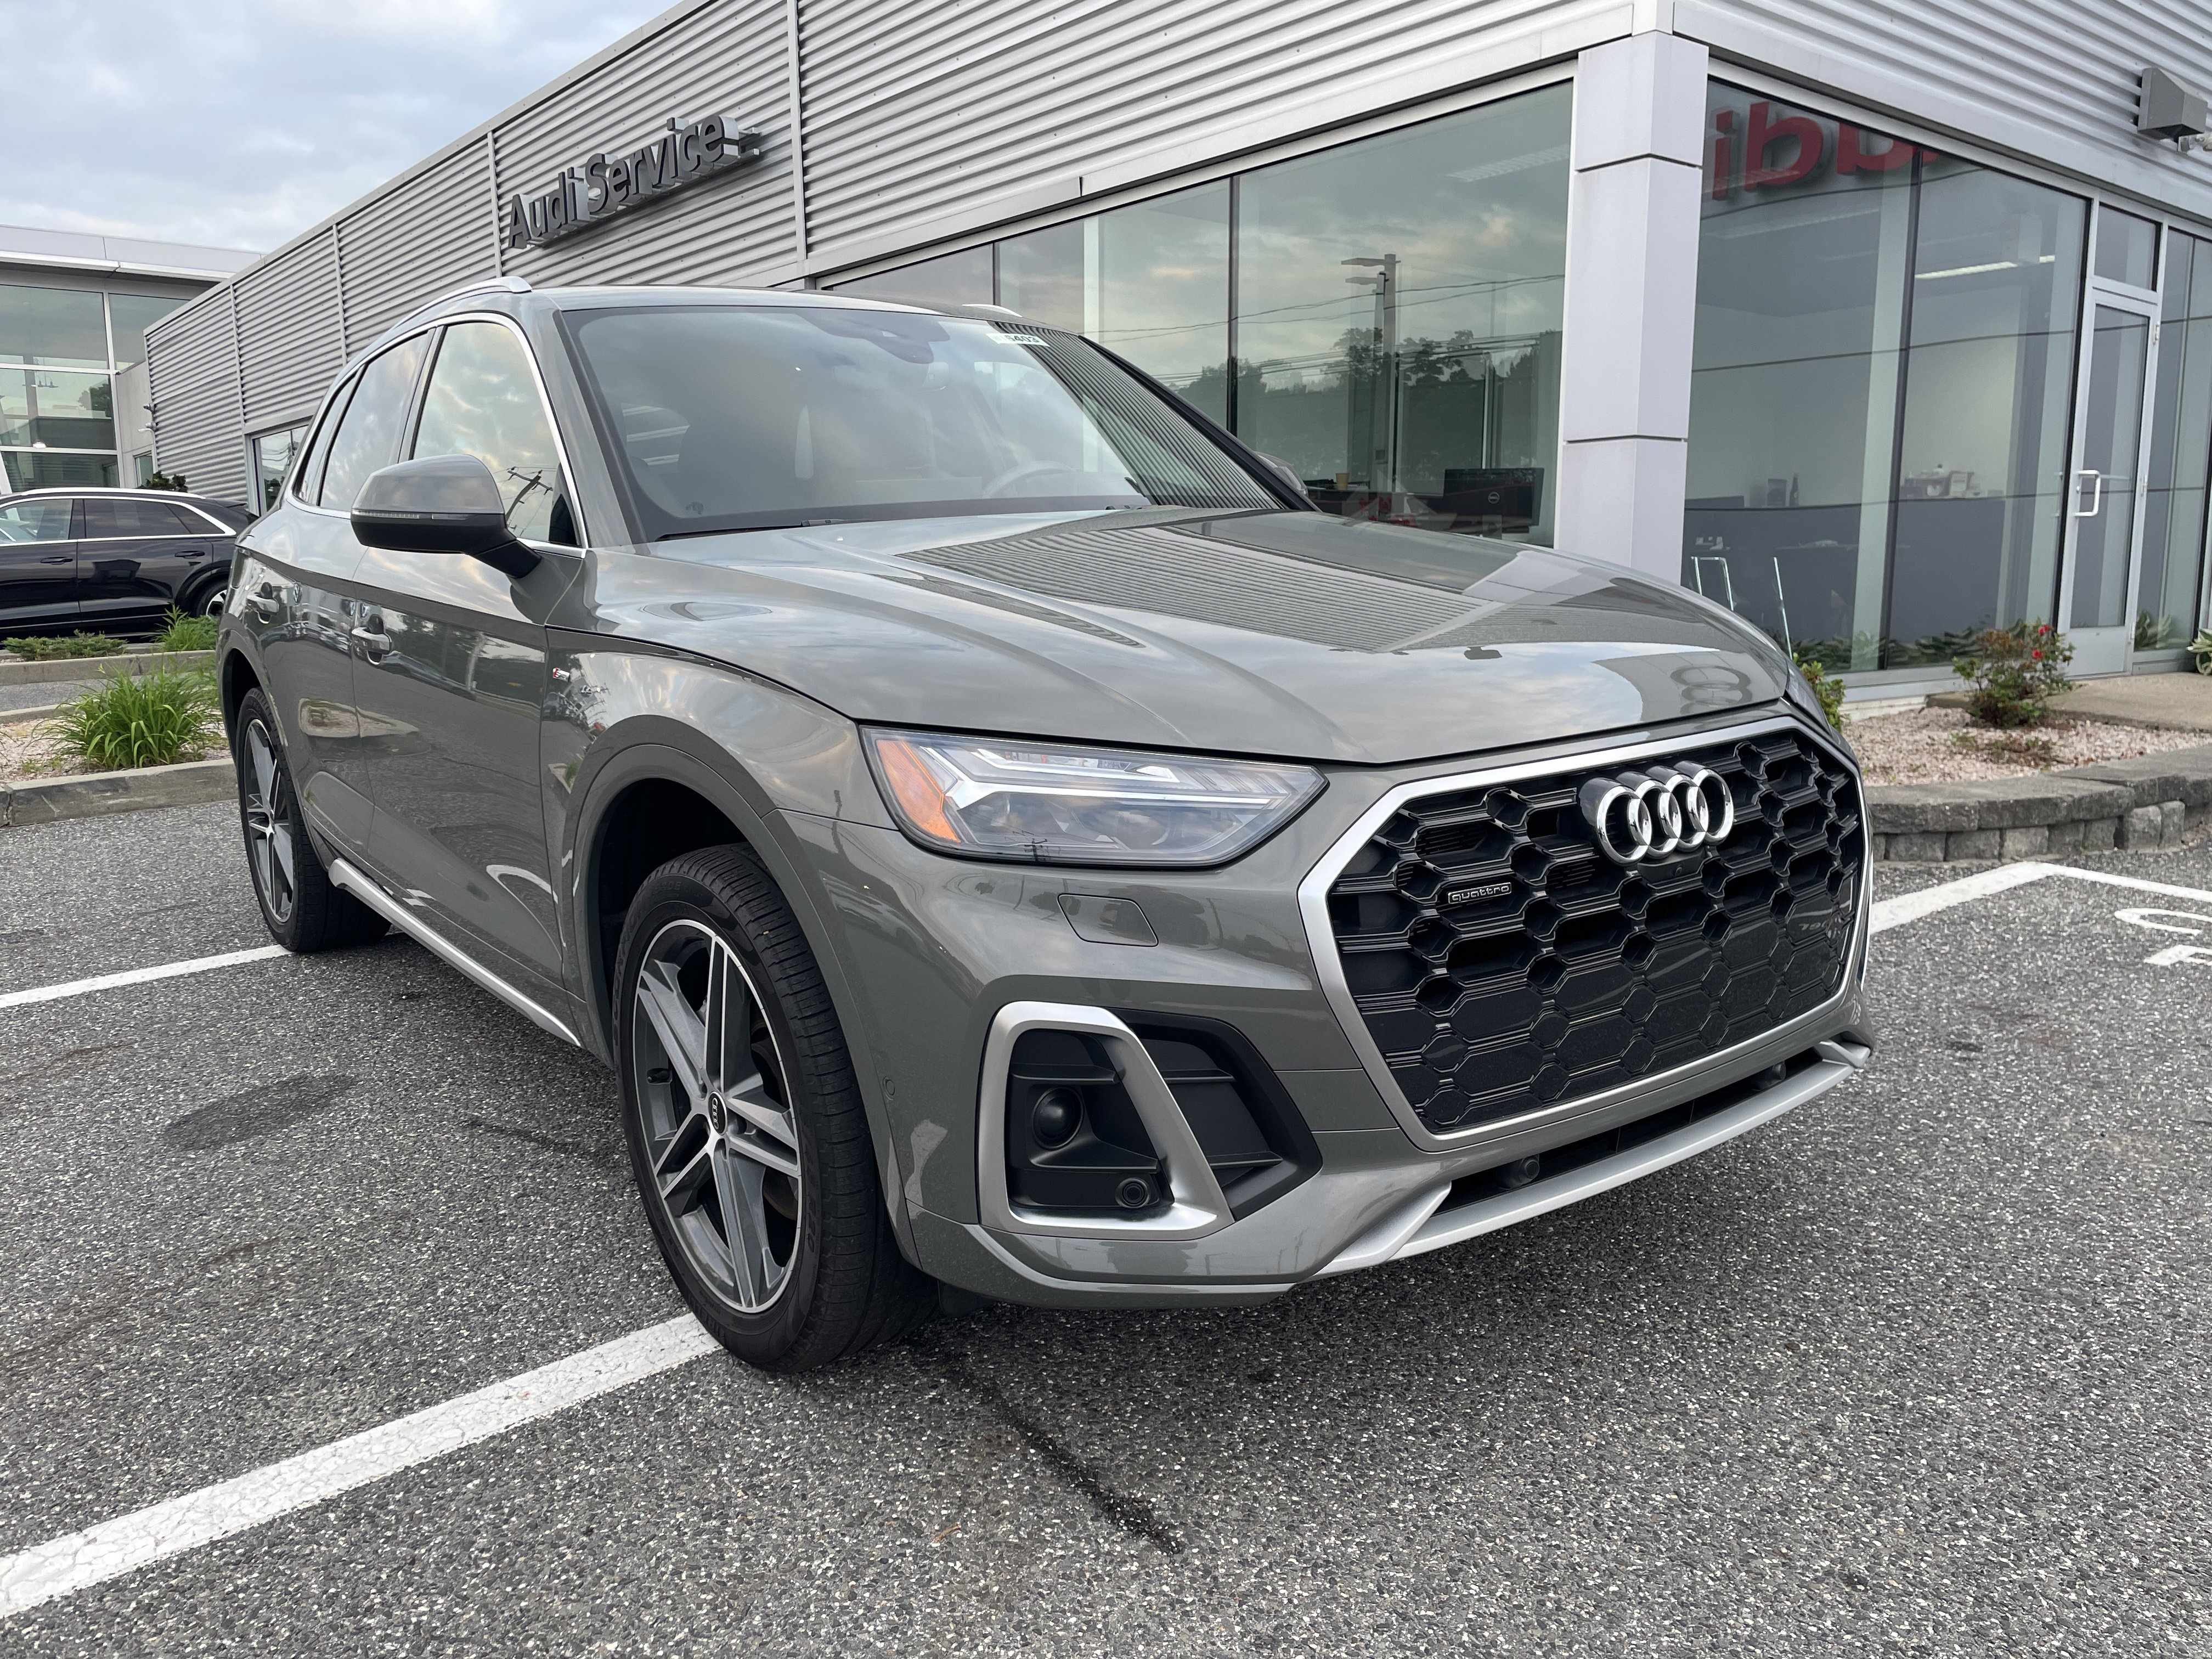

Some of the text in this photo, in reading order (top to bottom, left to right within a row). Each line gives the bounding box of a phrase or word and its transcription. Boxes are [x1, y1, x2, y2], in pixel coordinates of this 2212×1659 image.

[508, 114, 736, 249] Audi Service
[990, 335, 1040, 343] 6403
[1452, 885, 1509, 901] quattro
